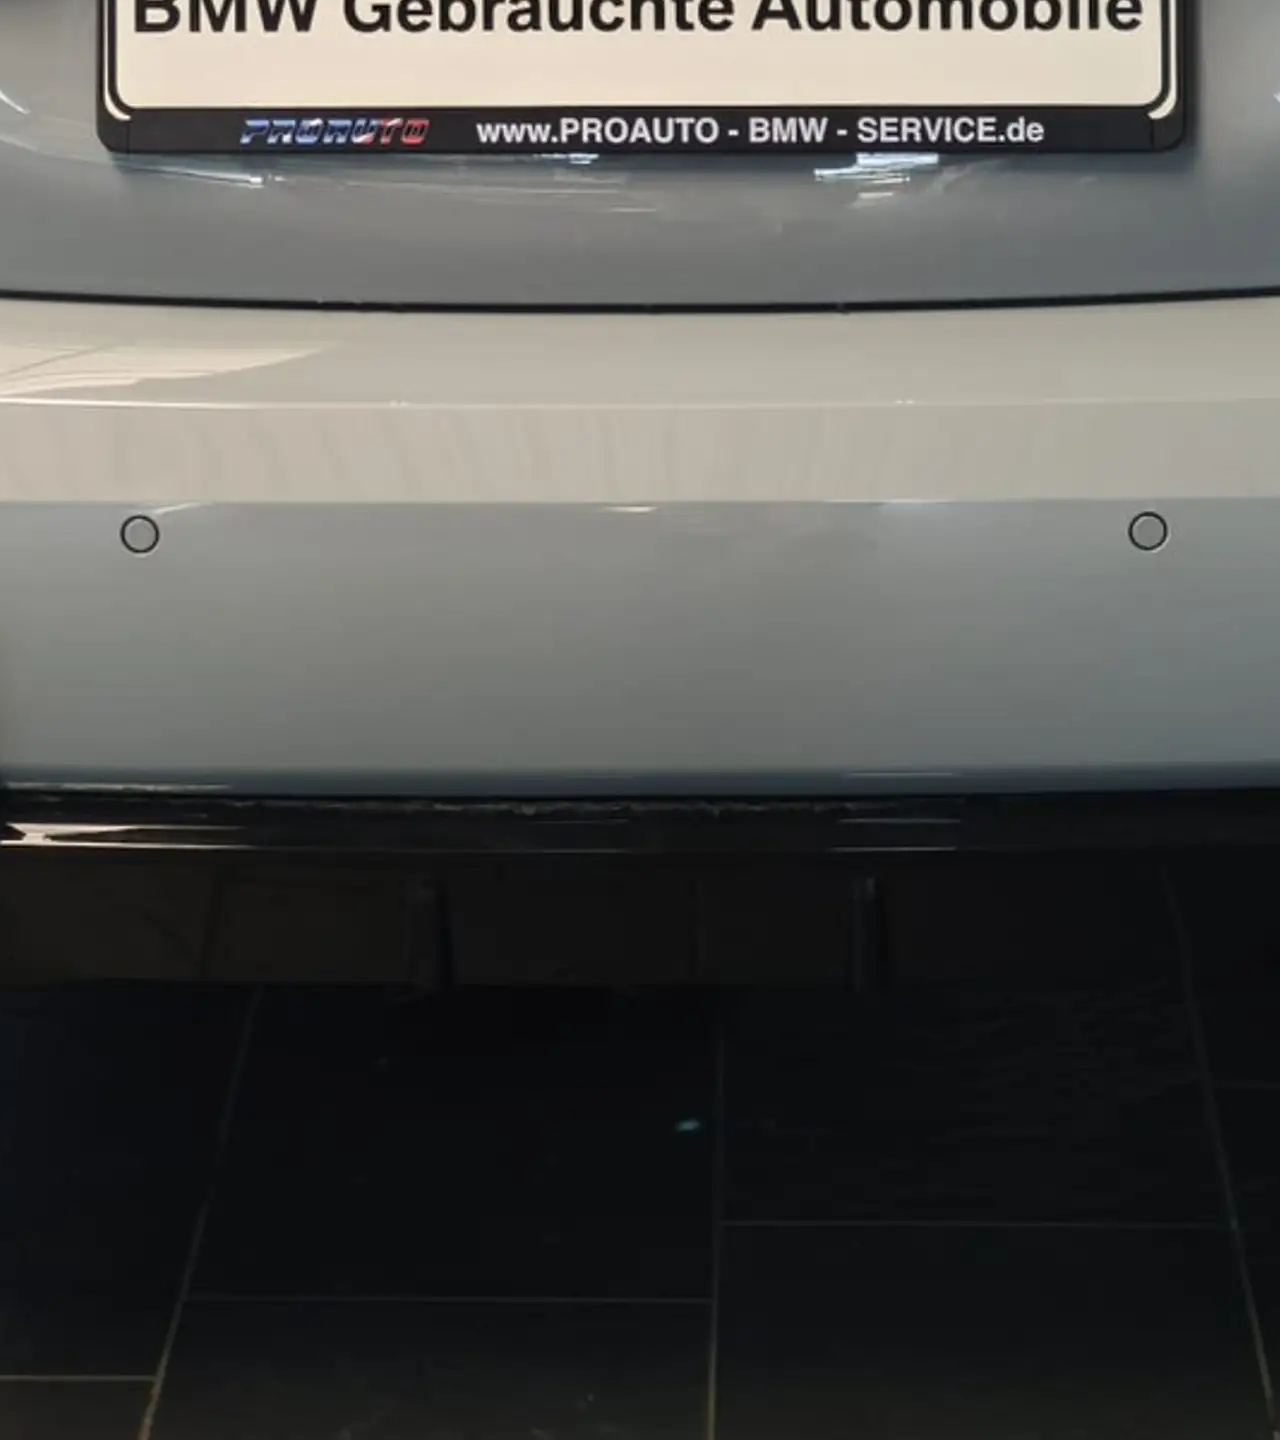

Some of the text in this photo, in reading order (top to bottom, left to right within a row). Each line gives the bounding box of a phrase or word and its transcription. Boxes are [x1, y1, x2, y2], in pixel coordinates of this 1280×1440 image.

[239, 117, 430, 145] PROAUTO
[476, 116, 720, 144] www.PROAUTO
[748, 116, 829, 144] BMW
[857, 116, 1045, 143] SERVICE.de
